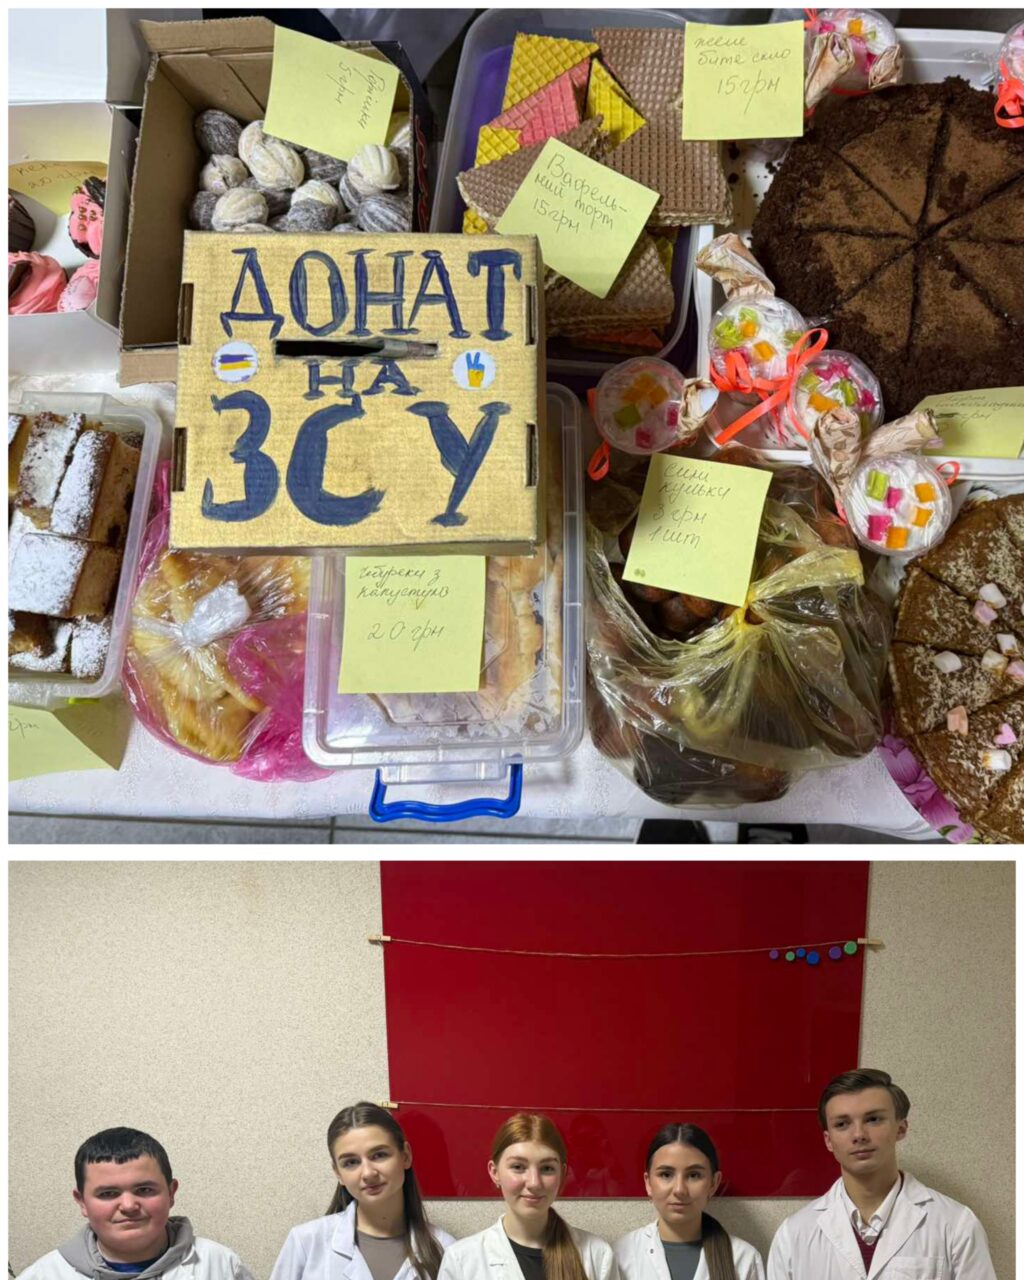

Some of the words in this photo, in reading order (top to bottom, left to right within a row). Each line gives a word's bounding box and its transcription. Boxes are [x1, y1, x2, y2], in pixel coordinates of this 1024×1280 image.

[219, 247, 523, 341] ДОНАТ
[303, 358, 423, 400] НА
[201, 390, 512, 527] ЗСУ
